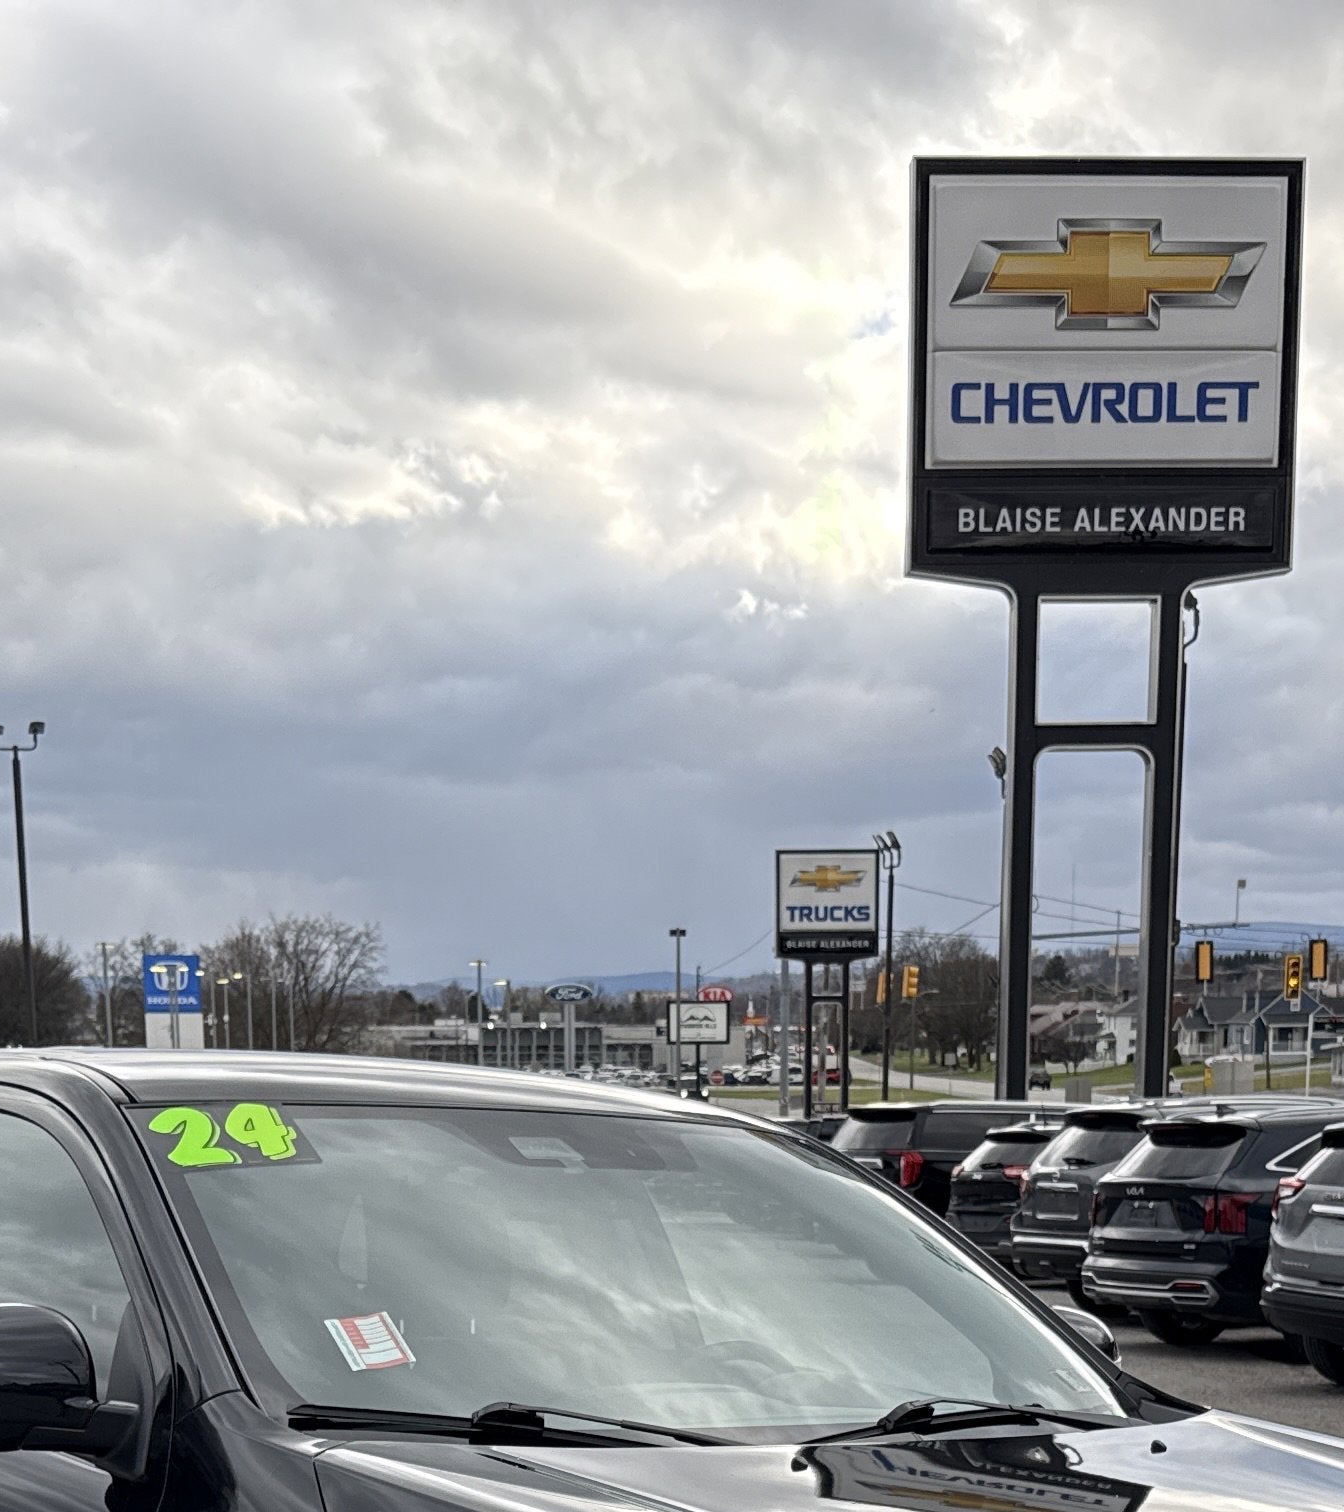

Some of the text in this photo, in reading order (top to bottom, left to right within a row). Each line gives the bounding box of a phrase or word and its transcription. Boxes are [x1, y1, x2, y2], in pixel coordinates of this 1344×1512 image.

[950, 381, 1260, 424] CHEVROLET
[957, 506, 1246, 533] BLAISE ALEXANDER
[785, 905, 871, 922] TRUCKS
[785, 940, 870, 949] BLAISE ALEXANDER
[146, 996, 198, 1005] HODA
[555, 987, 584, 1001] Ford
[148, 1103, 297, 1168] 24
